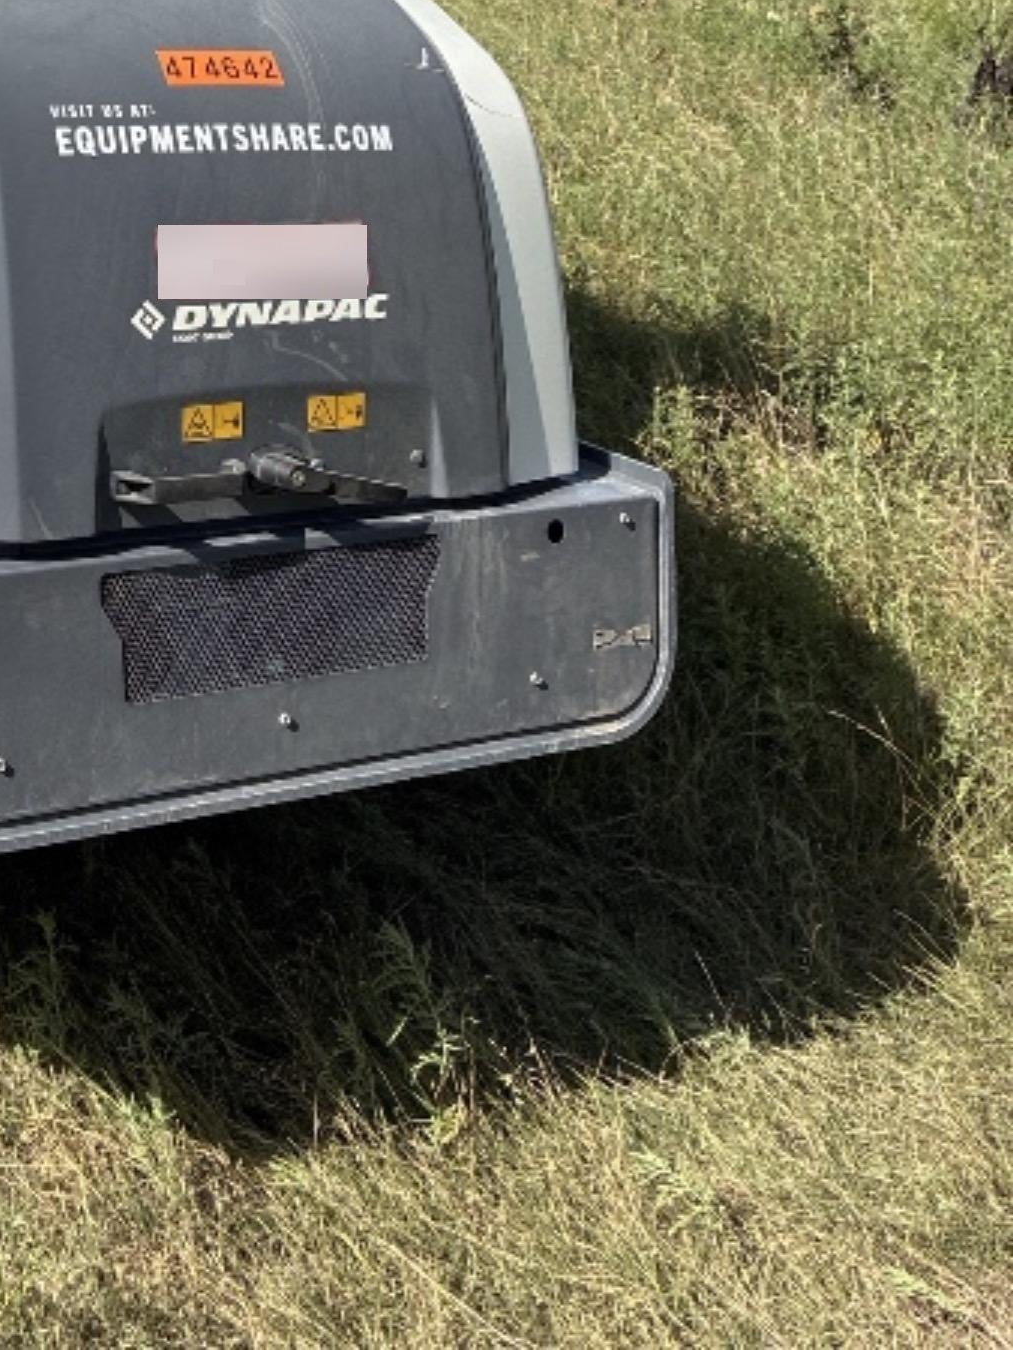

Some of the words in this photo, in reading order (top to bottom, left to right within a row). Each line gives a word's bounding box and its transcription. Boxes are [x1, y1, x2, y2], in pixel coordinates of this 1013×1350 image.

[166, 55, 280, 79] 474642
[49, 104, 93, 119] VISIT
[100, 104, 124, 119] US
[55, 122, 393, 157] EQUIPMENTSHARE.COM
[172, 293, 389, 332] DYNAPAC
